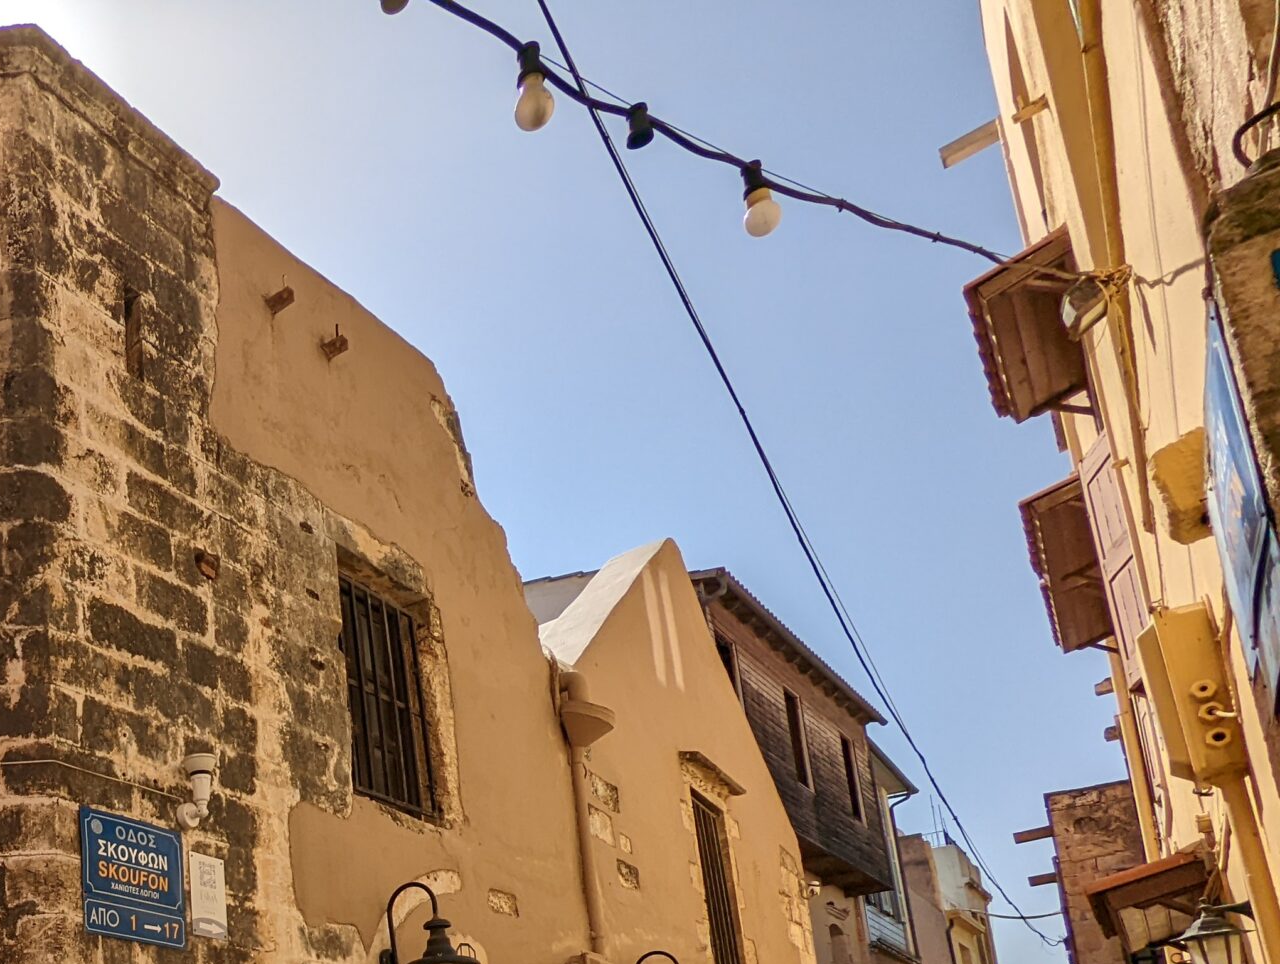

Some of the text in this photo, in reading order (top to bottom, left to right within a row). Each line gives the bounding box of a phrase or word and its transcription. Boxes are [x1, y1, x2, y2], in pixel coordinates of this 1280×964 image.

[116, 826, 156, 847] ΟΔΟΣ
[97, 839, 168, 871] ΣΚΟΥΦΩΝ
[98, 860, 168, 892] SKOUFON
[90, 907, 179, 938] ΑΠΟ 1 17
